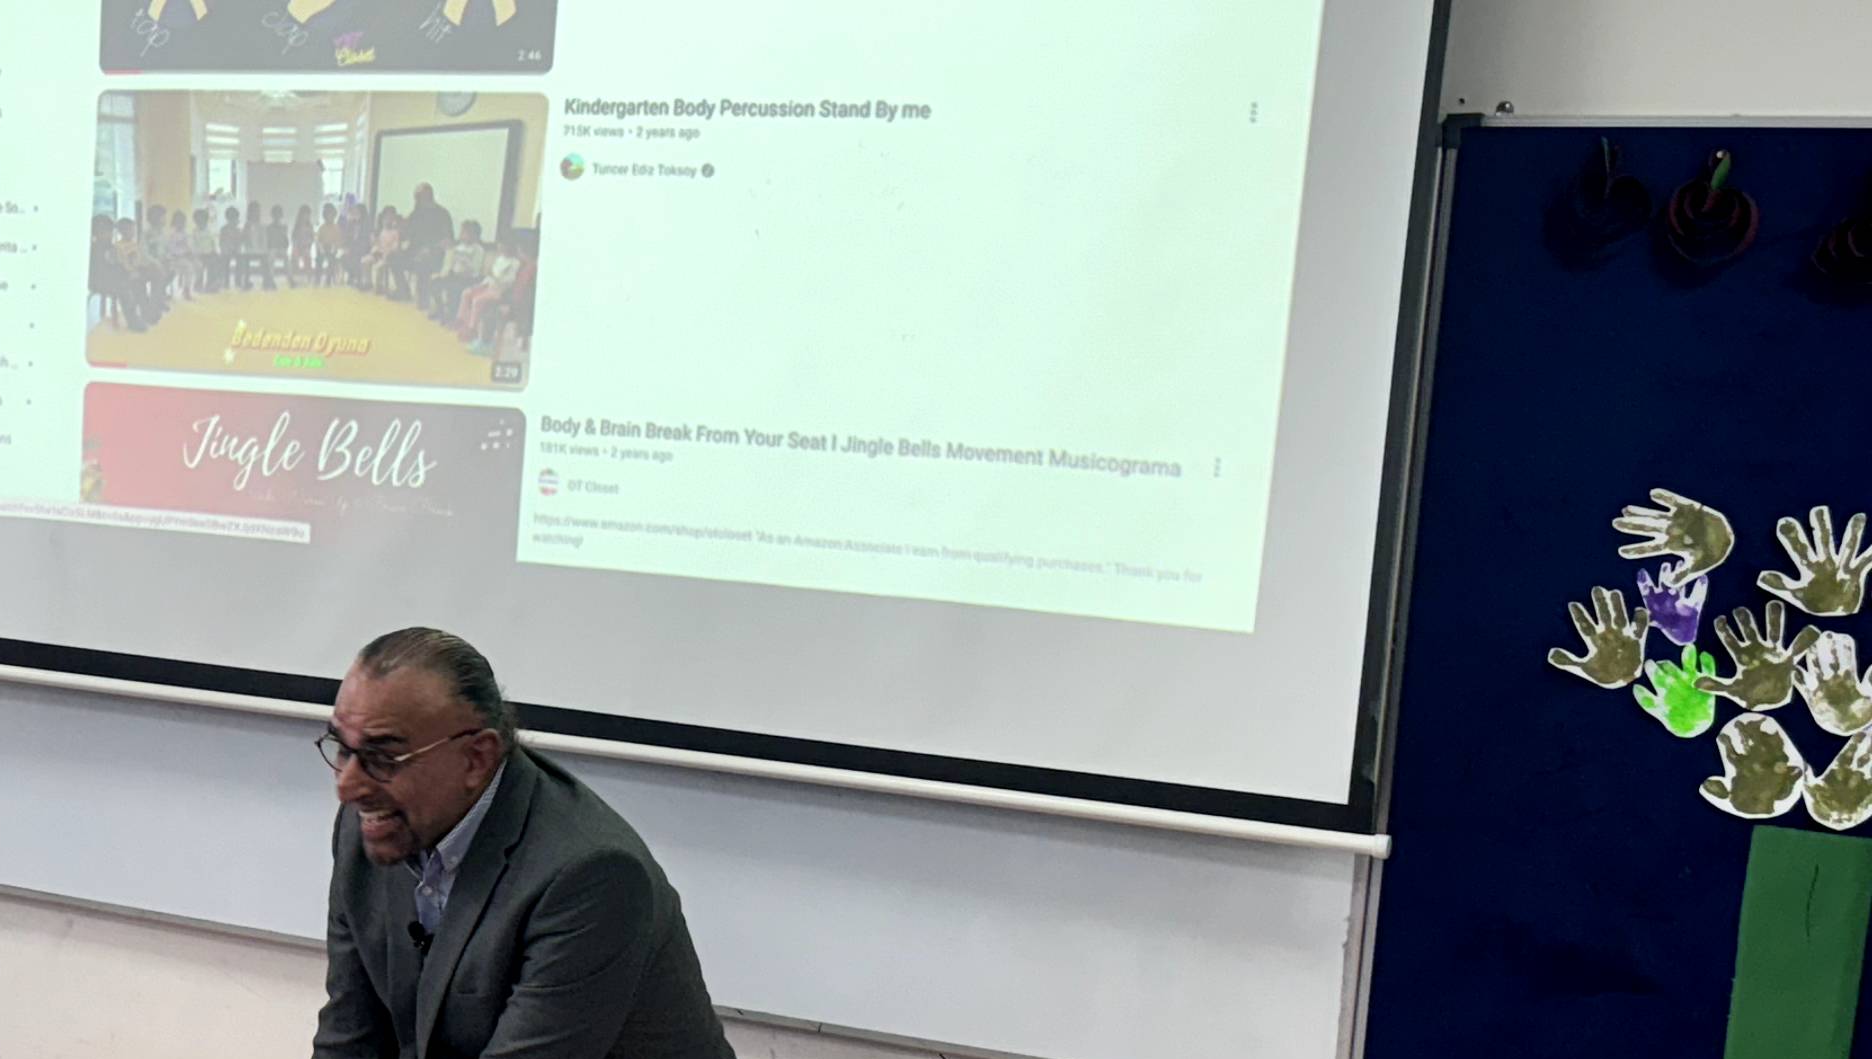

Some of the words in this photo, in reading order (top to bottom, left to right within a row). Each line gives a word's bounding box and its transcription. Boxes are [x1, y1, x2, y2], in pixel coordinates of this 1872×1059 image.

[564, 98, 669, 120] Kindergarten
[673, 98, 716, 120] Body
[719, 98, 816, 118] Percussion
[819, 99, 871, 119] Stand
[875, 100, 898, 123] By
[901, 103, 932, 120] me
[593, 125, 625, 138] views
[635, 125, 644, 139] 2
[645, 126, 676, 140] years
[678, 129, 701, 141] ago
[183, 409, 306, 491] Jingle
[316, 417, 438, 488] Bells
[540, 415, 582, 438] Body
[584, 418, 597, 436] &
[600, 419, 642, 439] Brain
[645, 421, 692, 442] Break
[696, 424, 740, 445] From
[744, 427, 784, 448] Your
[787, 430, 828, 451] Seat
[840, 434, 894, 458] Jingle
[897, 437, 941, 459] Bells
[946, 440, 1044, 467] Movement
[1048, 448, 1183, 478] Musicograma
[569, 444, 600, 457] views
[620, 447, 650, 461] years
[651, 450, 674, 463] ago
